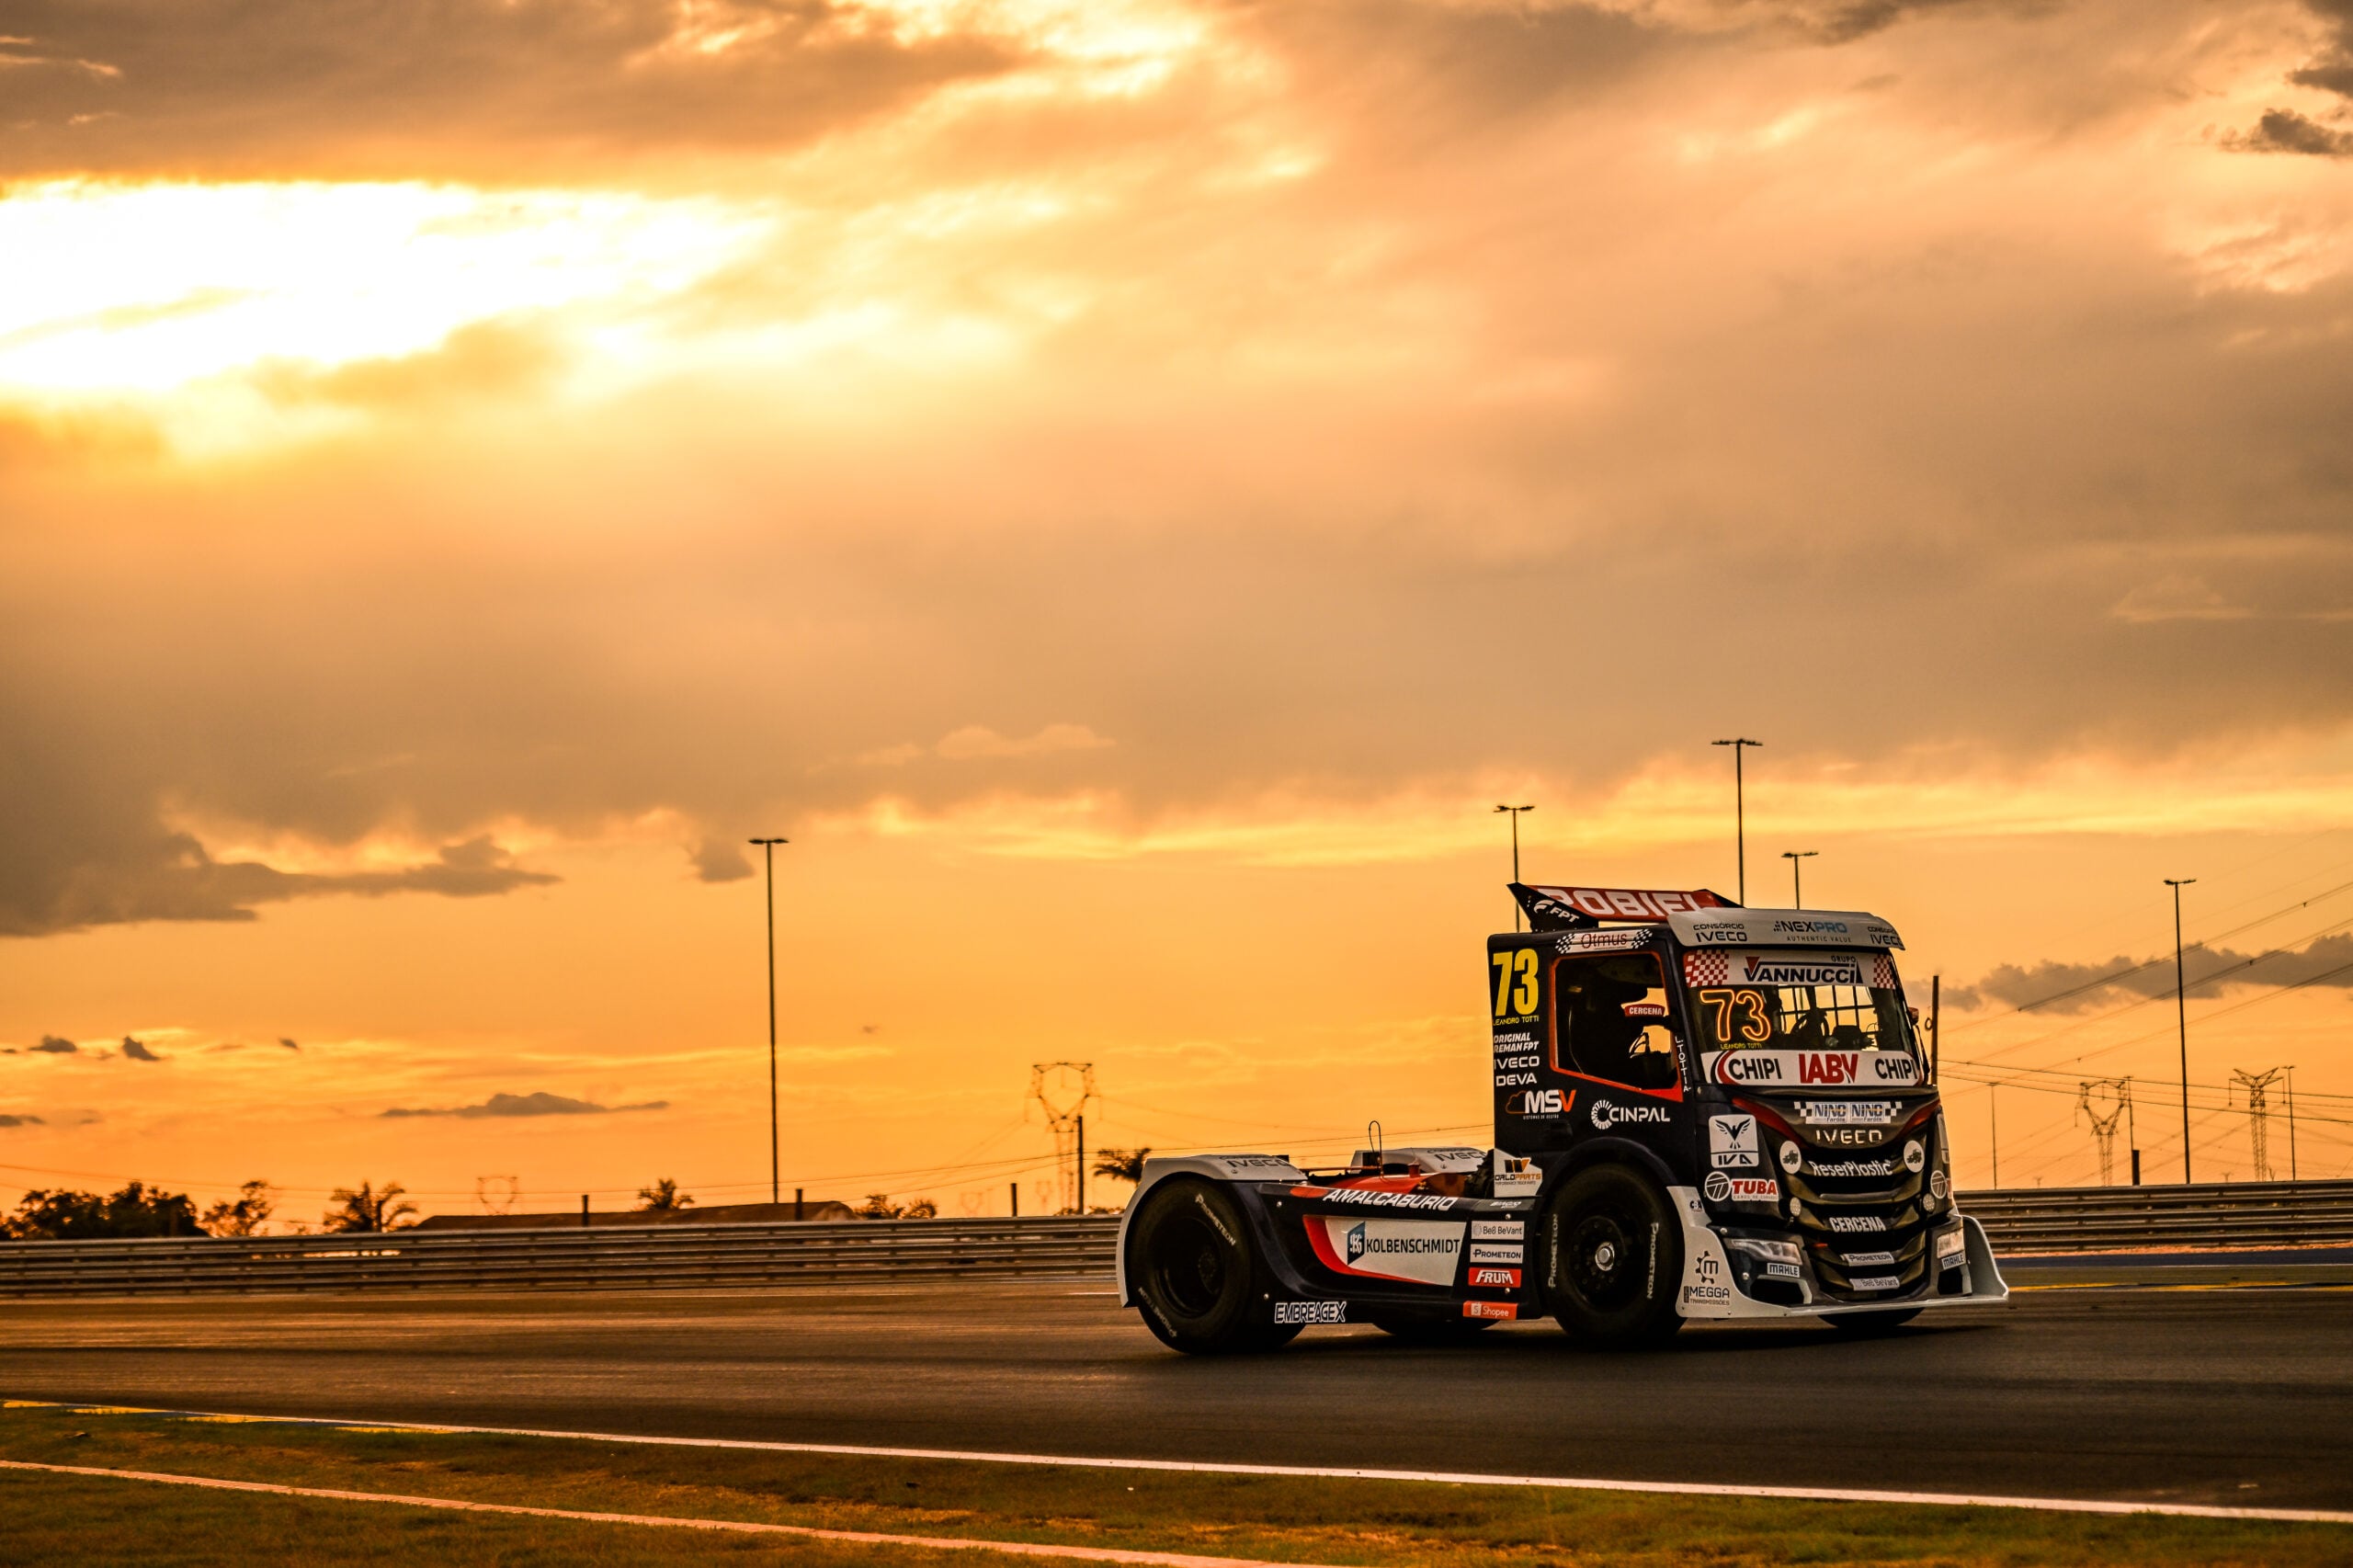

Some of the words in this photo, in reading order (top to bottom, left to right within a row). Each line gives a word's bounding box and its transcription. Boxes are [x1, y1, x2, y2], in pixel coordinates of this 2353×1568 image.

[1549, 905, 1580, 923] FPT
[1693, 922, 1745, 931] CONSÓRCIO
[1777, 921, 1848, 933] NEXPRO
[1581, 933, 1628, 949] Otmus
[1696, 932, 1747, 943] IVECO
[1831, 955, 1857, 963] GRUPO
[1493, 948, 1539, 1017] 73
[1629, 1006, 1663, 1016] CERCENA
[1700, 989, 1771, 1041] 73
[1494, 1032, 1530, 1043] ORIGINAL
[1494, 1042, 1523, 1053] REMAN
[1523, 1040, 1540, 1051] FPT
[1494, 1056, 1540, 1070] IVECO
[1728, 1058, 1782, 1080] CHIPI
[1798, 1052, 1859, 1085] IABV
[1875, 1058, 1917, 1080] CHIPI
[1496, 1073, 1537, 1086] DEVA
[1525, 1089, 1576, 1113] MSV
[1609, 1108, 1670, 1122] CINPAL
[1814, 1105, 1847, 1117] NINO
[1852, 1105, 1883, 1117] NINO
[1816, 1130, 1881, 1144] IVECO
[1808, 1160, 1893, 1176] ReserPlastic
[1733, 1180, 1777, 1195] TUBA
[1323, 1188, 1459, 1211] AMALCABURIO
[1498, 1226, 1522, 1234] BeVant
[1829, 1216, 1886, 1233] CERCENA
[1366, 1238, 1461, 1254] KOLBENSCHMIDT
[1943, 1255, 1964, 1267] MAHLE
[1475, 1269, 1514, 1284] FRUM
[1769, 1264, 1799, 1276] MAHLE
[1689, 1286, 1730, 1298] MEGGA
[1274, 1301, 1347, 1324] EMBREAGEX
[1483, 1305, 1509, 1318] Shopee
